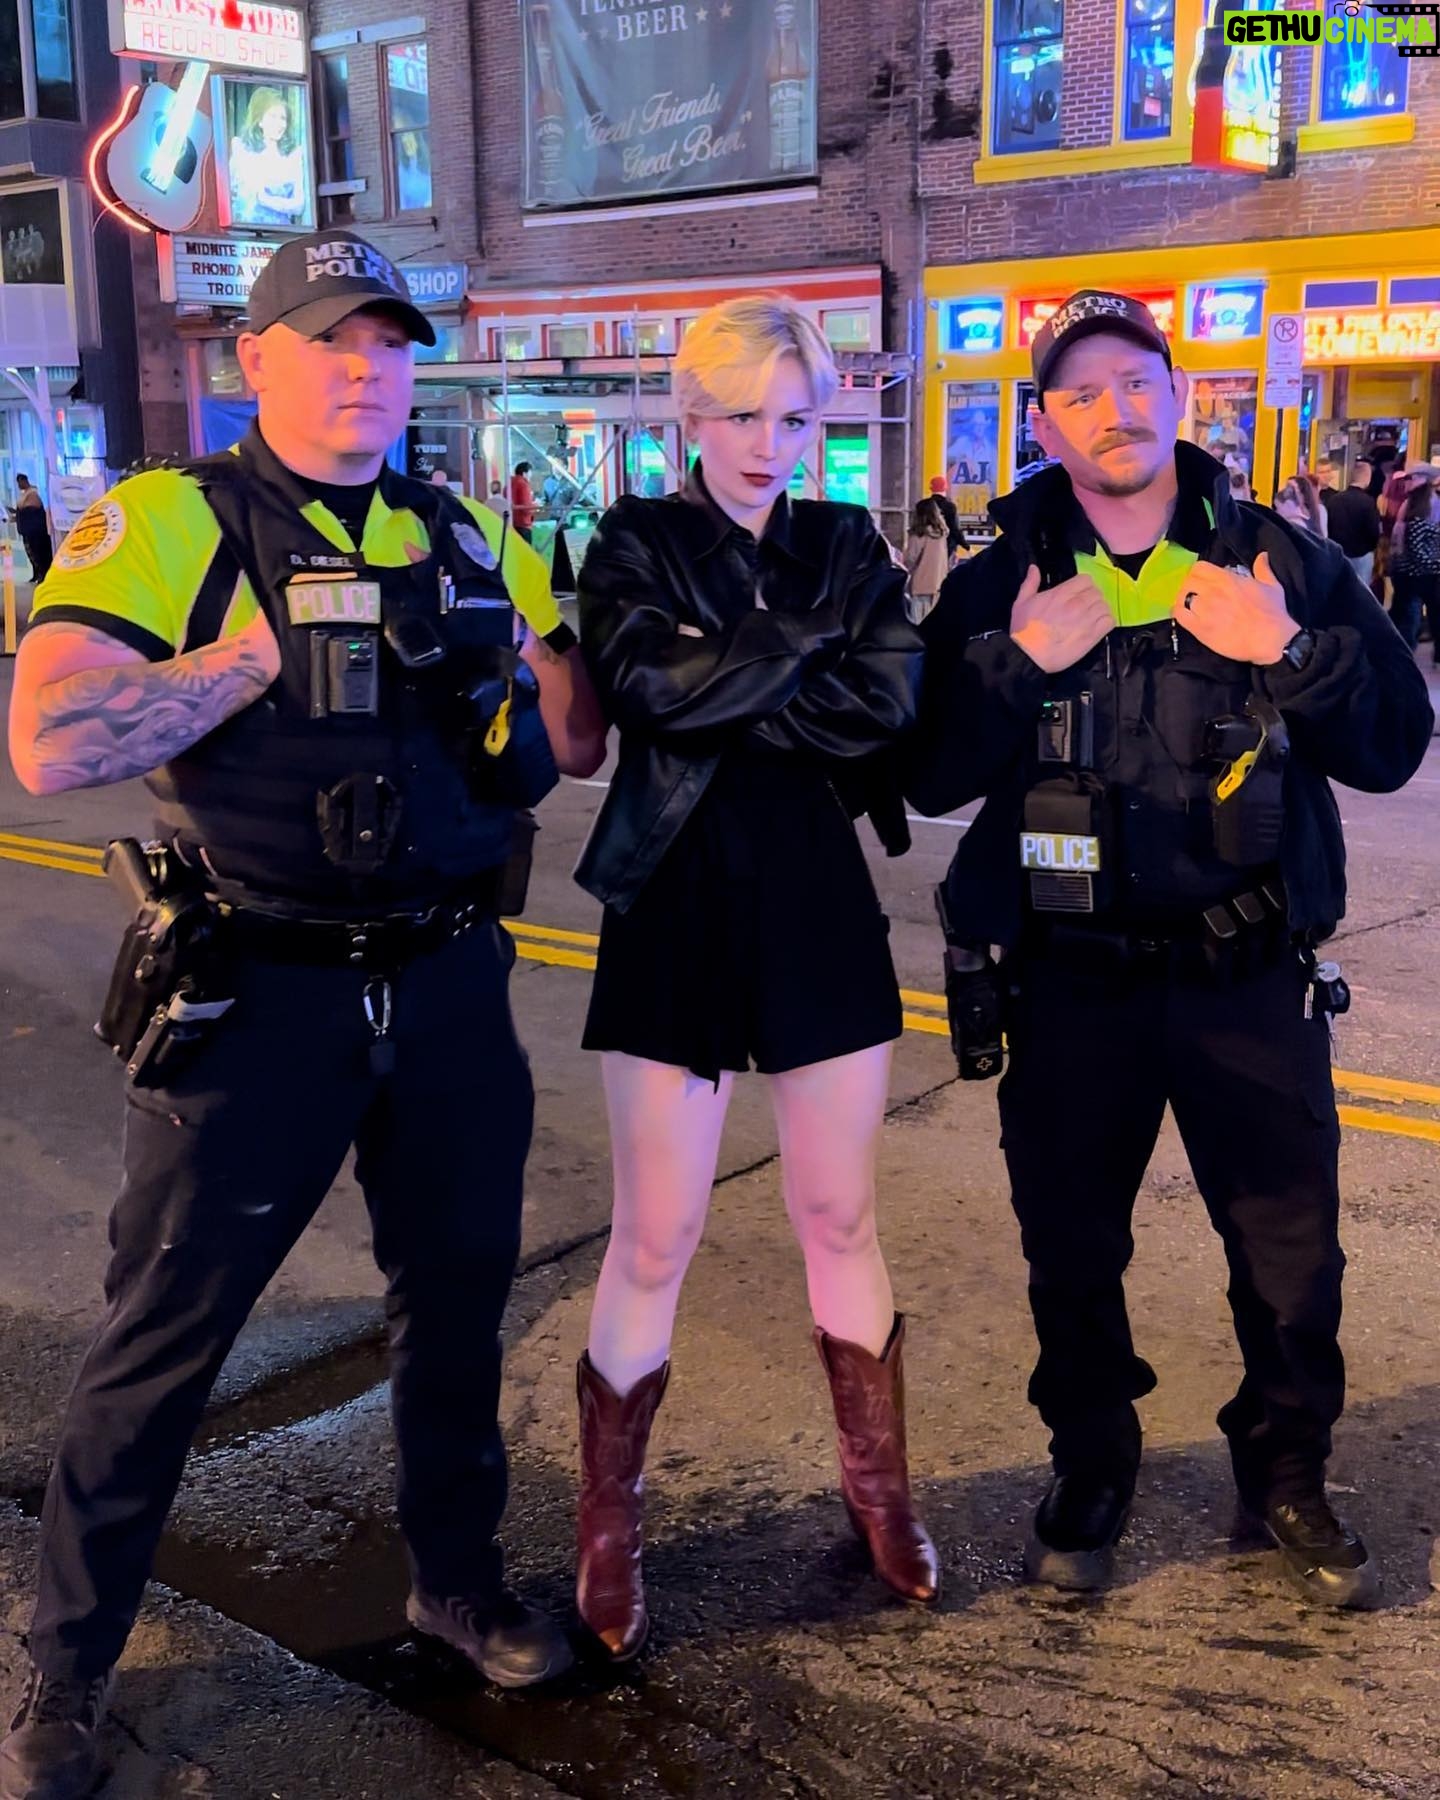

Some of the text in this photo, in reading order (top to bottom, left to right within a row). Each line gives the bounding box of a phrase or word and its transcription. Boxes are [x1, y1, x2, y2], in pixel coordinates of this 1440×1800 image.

[616, 5, 688, 41] BEER
[142, 21, 290, 66] RECORD SHOP
[621, 140, 678, 183] Great
[185, 242, 237, 257] MIDNITE
[192, 261, 245, 277] RHONDA
[406, 271, 458, 296] SHOP
[1051, 296, 1127, 331] METRO
[1303, 328, 1440, 359] SOMEWHE
[291, 586, 377, 620] POLICE
[1022, 836, 1098, 868] POLICE
